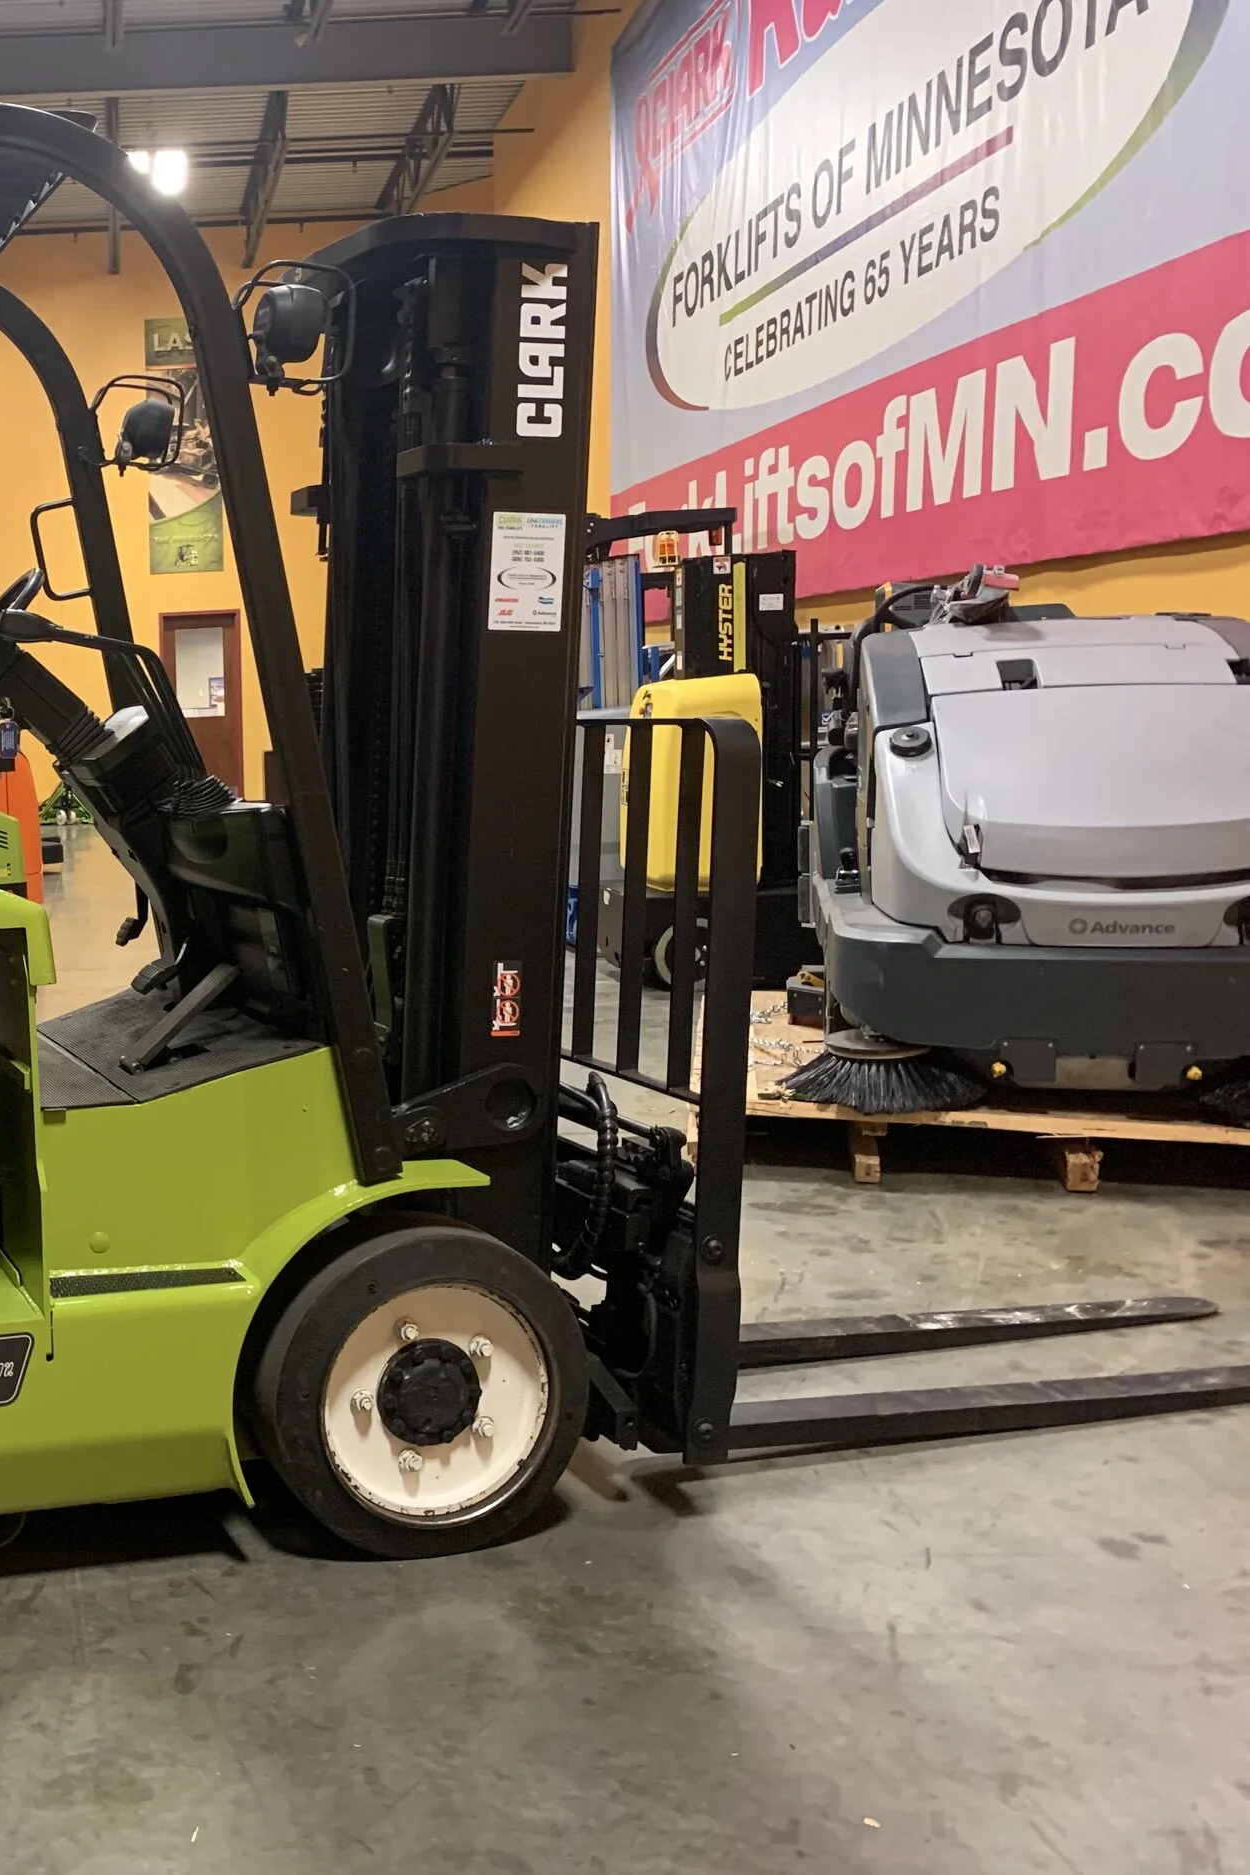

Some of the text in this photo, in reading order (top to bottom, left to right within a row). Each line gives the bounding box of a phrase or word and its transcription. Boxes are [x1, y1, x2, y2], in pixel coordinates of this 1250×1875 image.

[671, 182, 803, 328] FORKLIFTS
[812, 138, 856, 229] OF
[724, 185, 1001, 381] CELEBRATING 65 YEARS
[153, 332, 195, 352] LAS
[516, 262, 568, 438] CLARK
[718, 583, 733, 661] HYSTER
[1090, 920, 1176, 935] Advance
